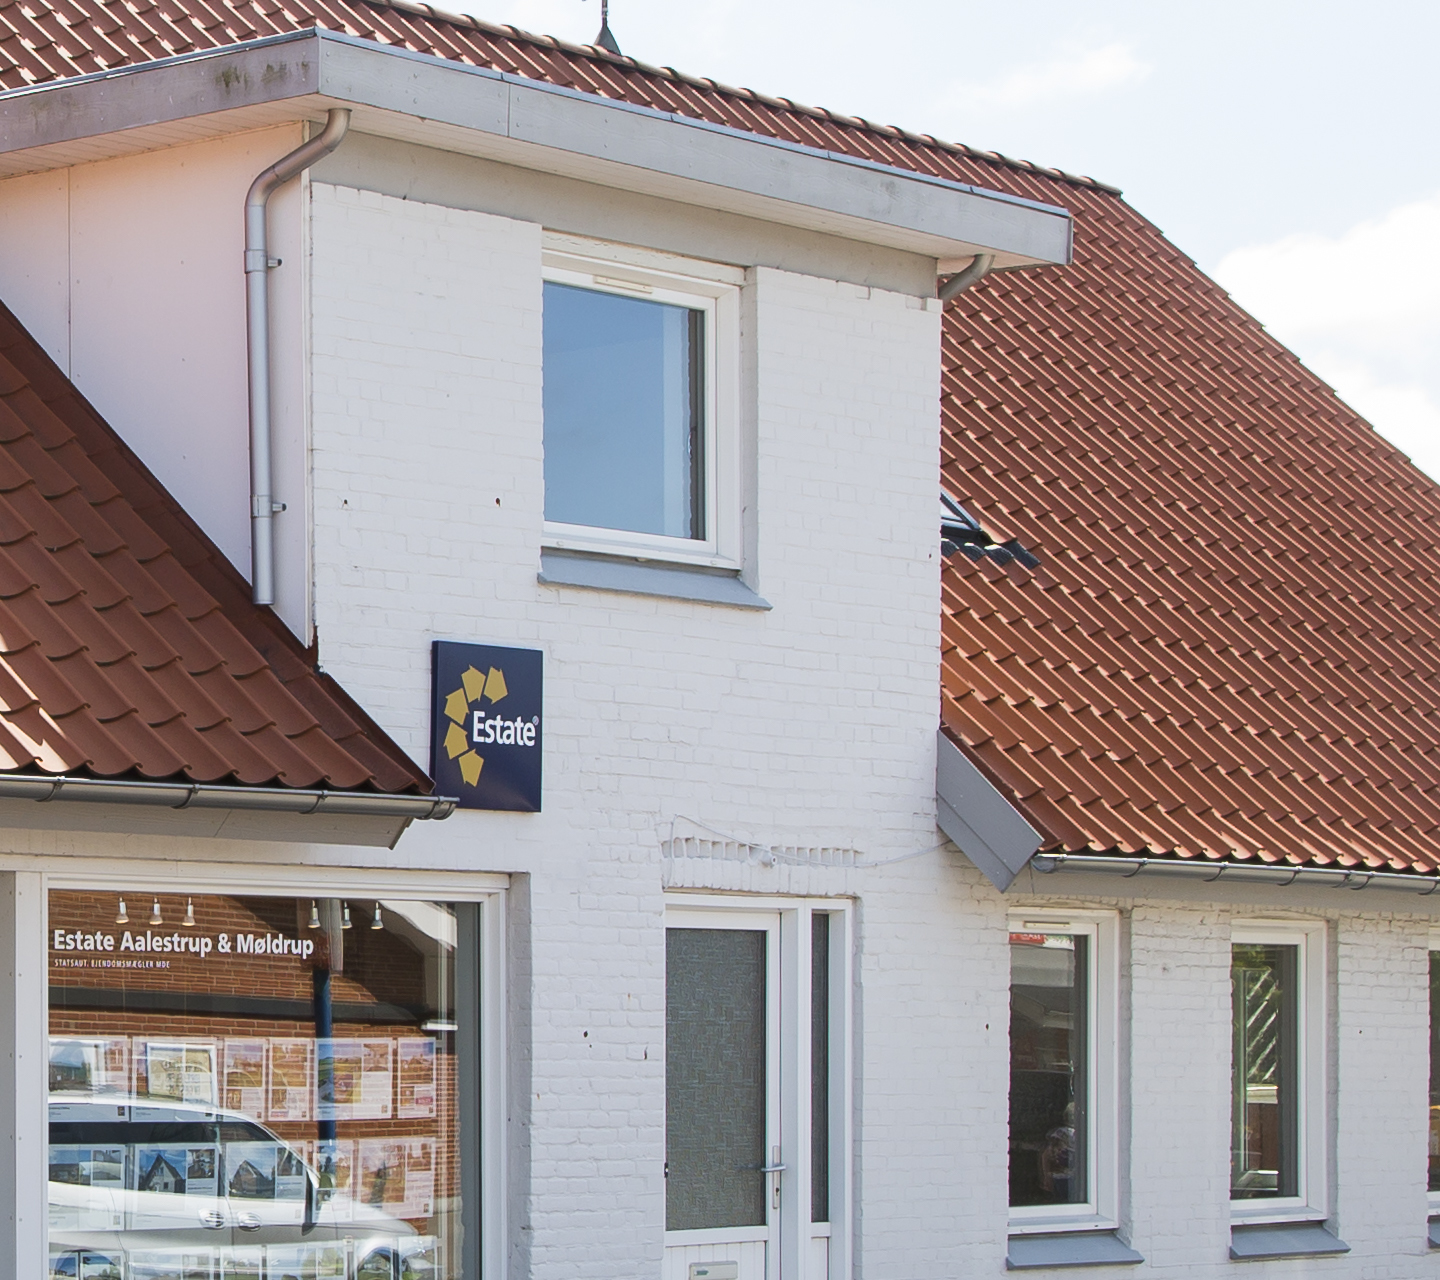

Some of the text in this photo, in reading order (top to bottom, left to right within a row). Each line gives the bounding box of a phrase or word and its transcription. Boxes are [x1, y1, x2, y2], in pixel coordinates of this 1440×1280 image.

[473, 711, 536, 746] Estate
[54, 929, 314, 959] Estate Aalestrup & Møldrup
[54, 959, 89, 968] STATSAUT.
